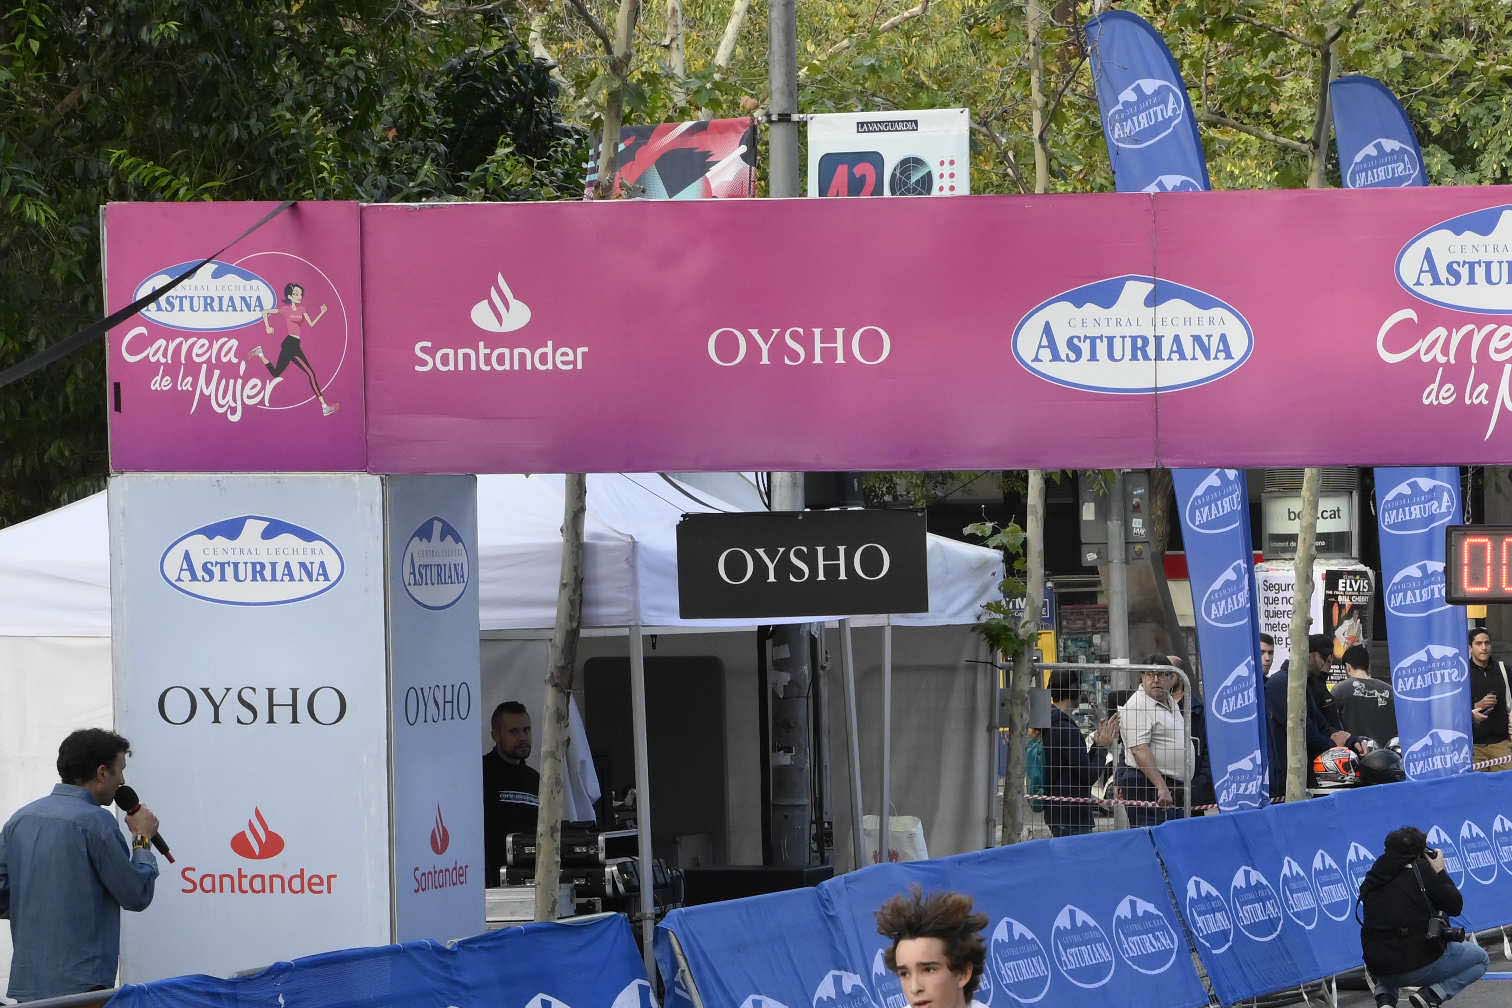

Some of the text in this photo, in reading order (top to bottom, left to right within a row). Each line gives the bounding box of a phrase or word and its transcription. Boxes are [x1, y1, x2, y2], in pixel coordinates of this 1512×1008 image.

[1068, 315, 1227, 329] CENTRAL LECHERA
[121, 326, 240, 363] Carrera
[414, 341, 589, 372] Santander
[707, 325, 891, 366] OYSHO
[1031, 319, 1235, 363] ASTURIANA
[150, 361, 284, 422] de la Mujer
[1422, 367, 1456, 405] de
[1464, 366, 1489, 405] la
[175, 549, 330, 583] ASTURIANA
[203, 546, 325, 556] CENTRAL LECHERA
[718, 544, 890, 585] OYSHO
[408, 556, 465, 588] ASTURIANA
[1338, 578, 1369, 591] ELVIS
[158, 684, 347, 726] OYSHO
[405, 681, 471, 727] OYSHO
[181, 866, 338, 894] Santander
[413, 861, 469, 894] Santander
